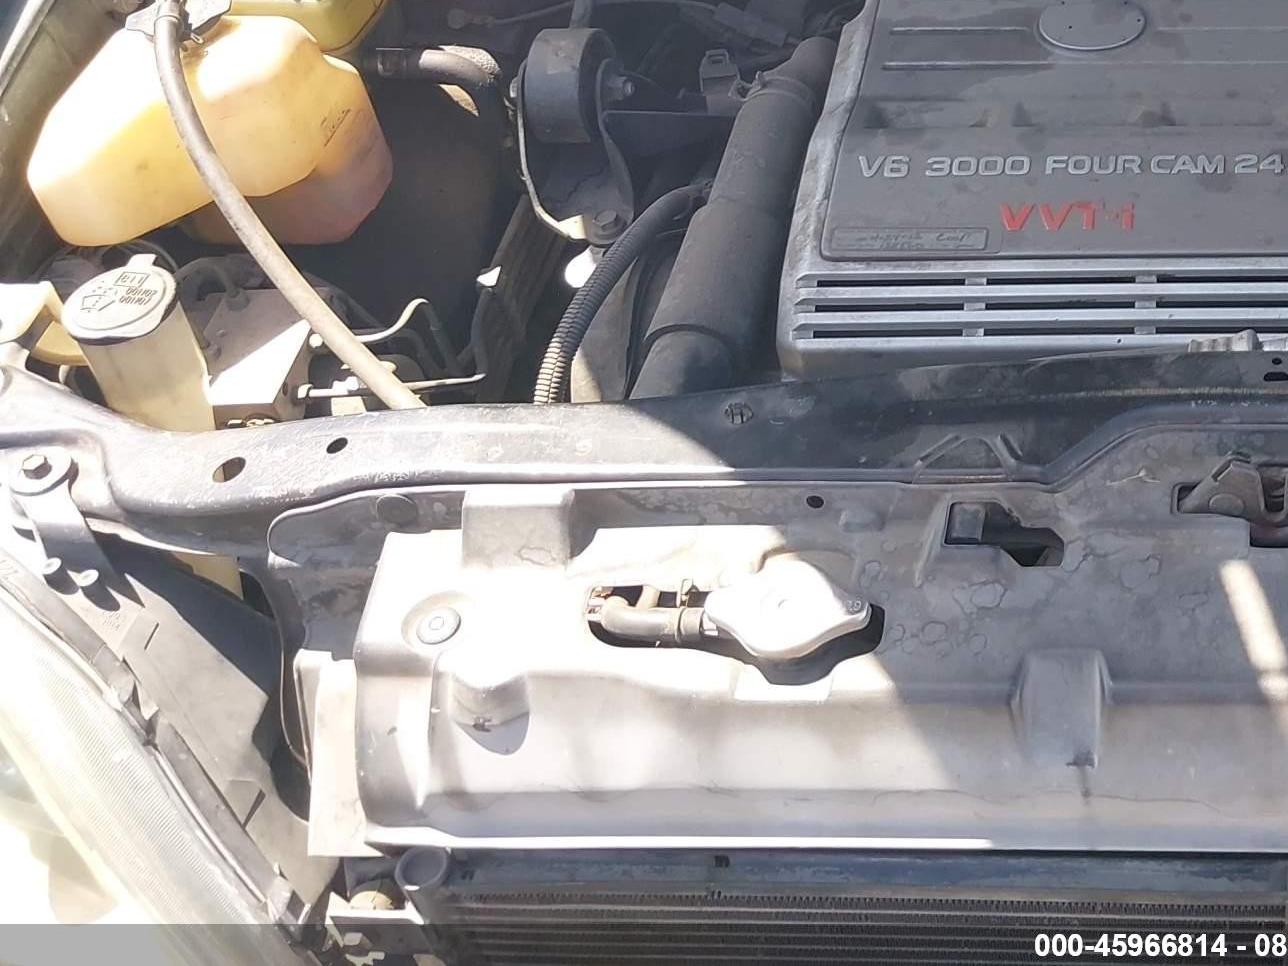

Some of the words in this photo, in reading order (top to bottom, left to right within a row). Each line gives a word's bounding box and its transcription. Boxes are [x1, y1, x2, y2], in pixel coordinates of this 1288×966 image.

[858, 155, 911, 178] V6
[926, 155, 1033, 178] 3000
[1047, 154, 1143, 175] FOUR
[1151, 154, 1227, 175] CAM
[1235, 153, 1287, 174] 24
